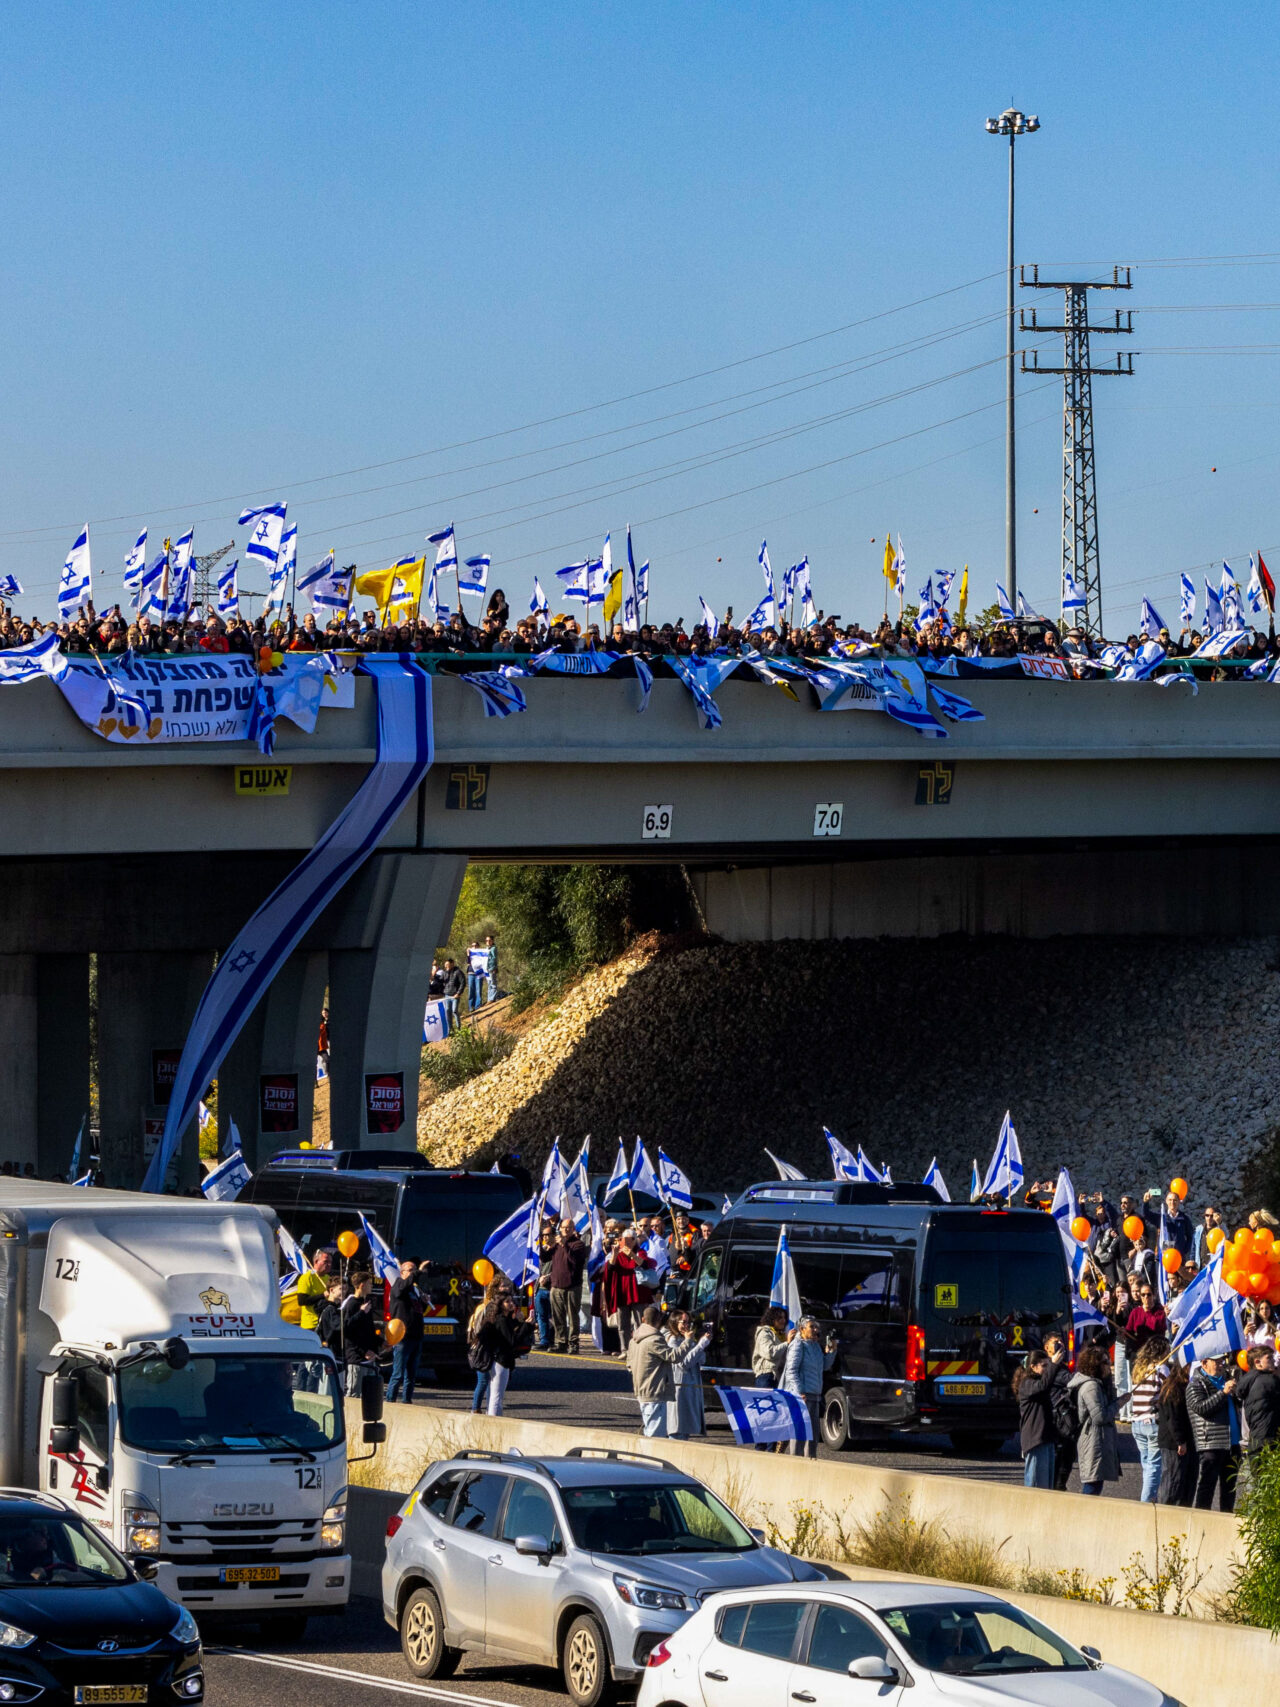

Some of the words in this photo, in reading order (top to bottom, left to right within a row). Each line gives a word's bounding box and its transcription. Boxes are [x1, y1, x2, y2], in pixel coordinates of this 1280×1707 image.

[645, 812, 670, 831] 6.9
[817, 810, 840, 829] 7.0
[264, 1088, 295, 1099] מסוכן
[370, 1087, 401, 1099] מסוכן
[370, 1100, 400, 1109] לישראל
[56, 1258, 75, 1281] 12
[73, 1260, 81, 1282] TON
[294, 1468, 316, 1489] 12
[213, 1502, 275, 1516] ISUZU
